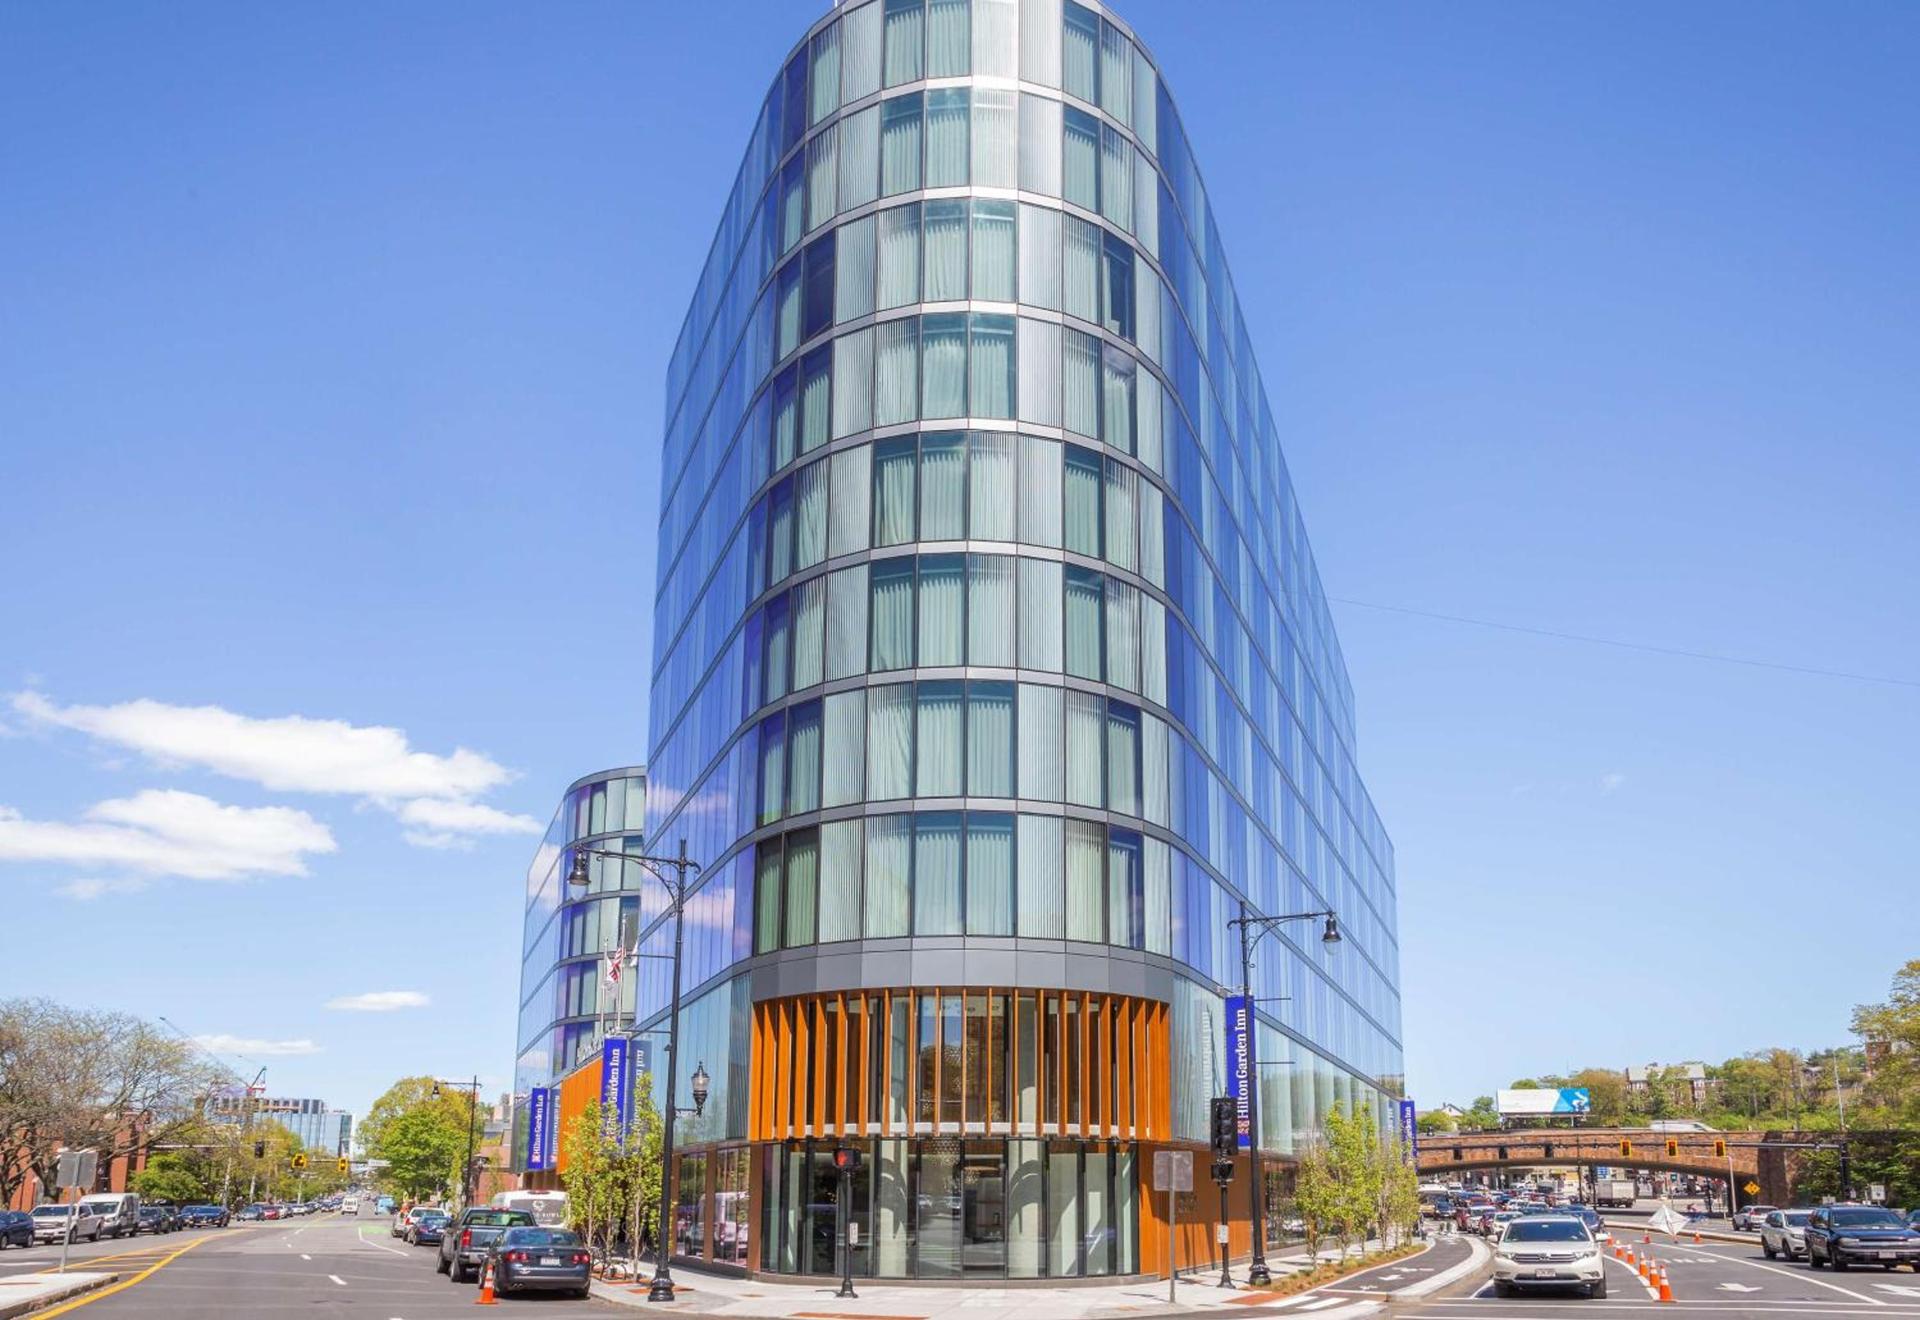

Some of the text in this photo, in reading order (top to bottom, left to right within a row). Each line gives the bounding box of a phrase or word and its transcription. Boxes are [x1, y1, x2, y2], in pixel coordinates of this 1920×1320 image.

[610, 1048, 620, 1066] Inn
[1235, 1009, 1249, 1118] Hilton Garden Inn
[535, 1095, 544, 1107] Inn
